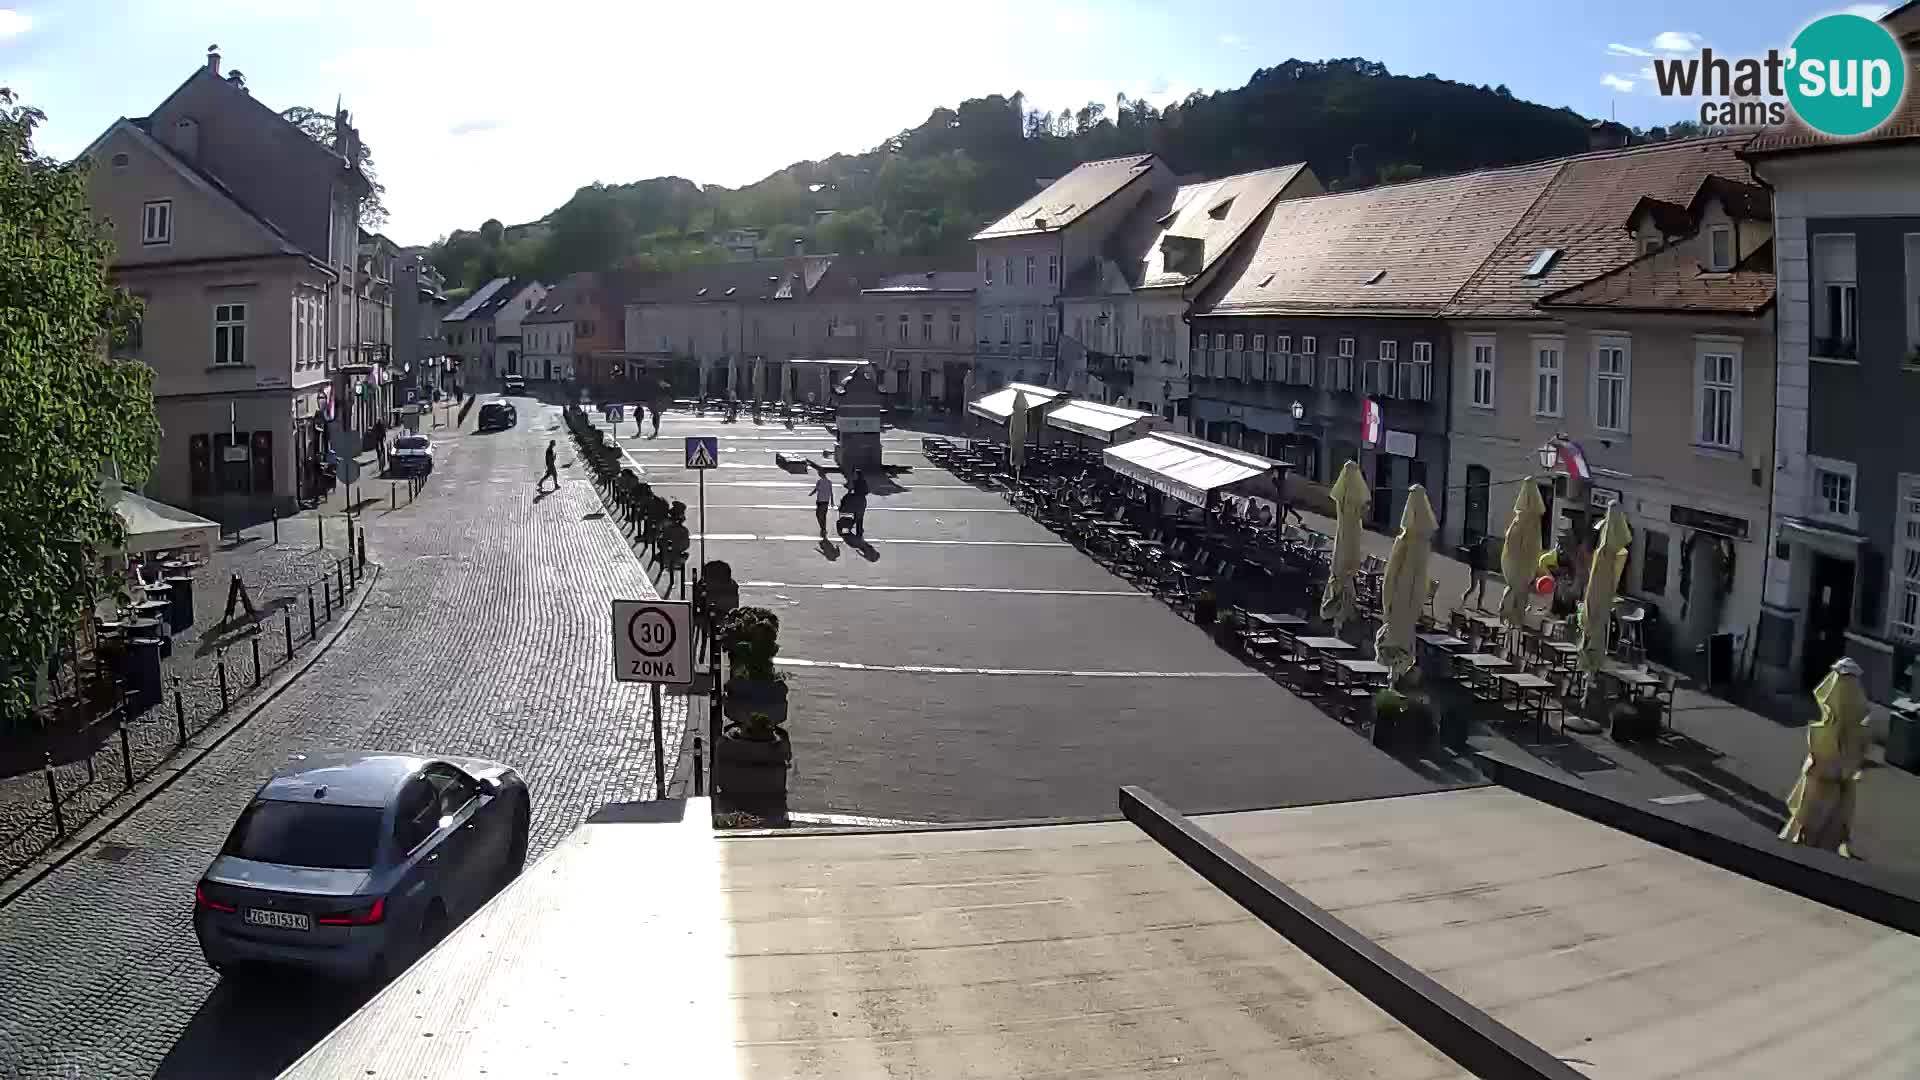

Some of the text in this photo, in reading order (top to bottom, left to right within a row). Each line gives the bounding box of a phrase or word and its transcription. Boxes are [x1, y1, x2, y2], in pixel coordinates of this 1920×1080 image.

[407, 391, 415, 401] P
[641, 623, 665, 644] 30
[631, 660, 676, 677] ZONA
